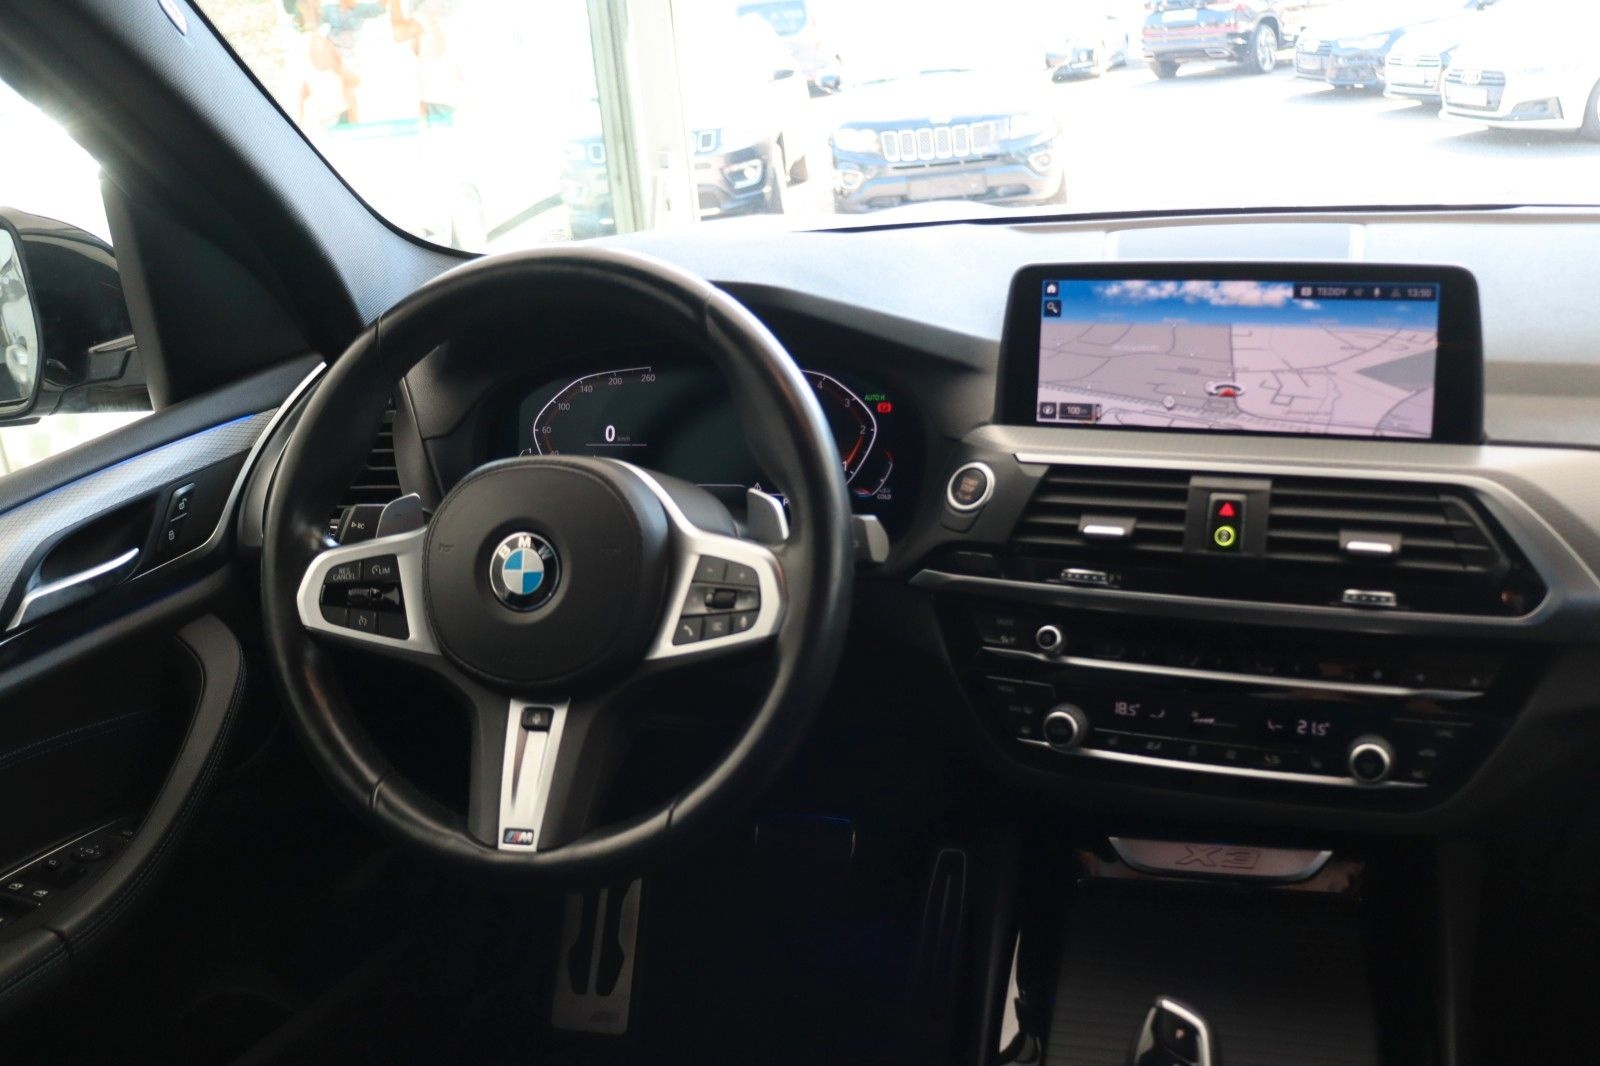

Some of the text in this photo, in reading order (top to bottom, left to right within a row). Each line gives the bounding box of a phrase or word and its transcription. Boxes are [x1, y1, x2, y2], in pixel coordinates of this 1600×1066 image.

[1317, 287, 1348, 297] TEDDY
[608, 377, 623, 385] 200
[641, 374, 656, 382] 260
[580, 385, 593, 393] 140
[844, 399, 850, 407] 3
[542, 426, 551, 434] 60
[605, 425, 616, 442] 0
[860, 425, 866, 434] 2
[498, 536, 553, 560] BMW
[1175, 845, 1261, 869] X3
